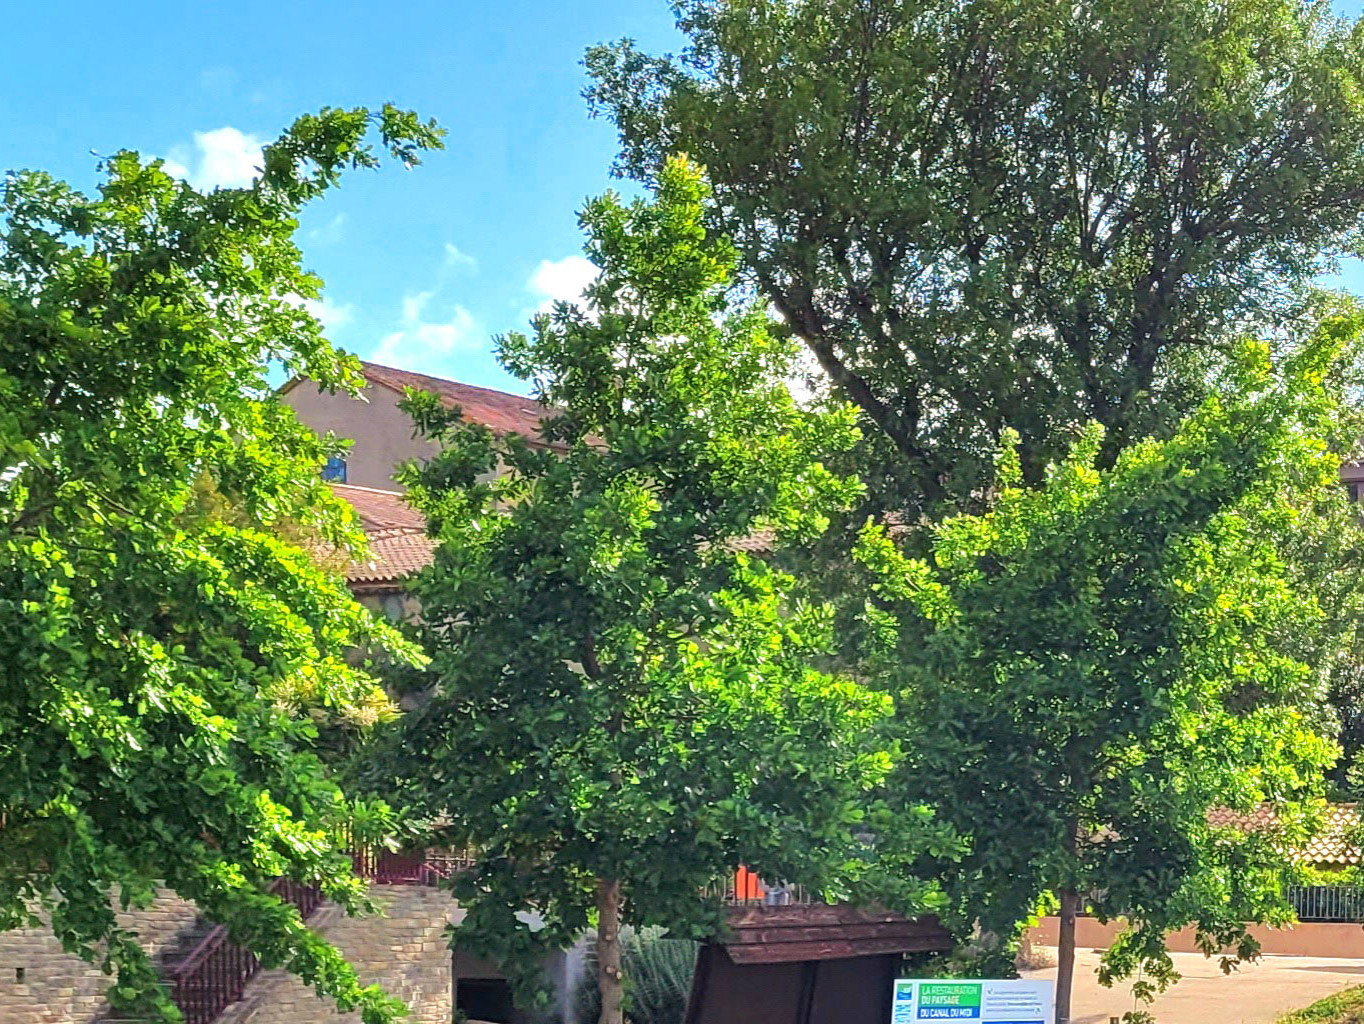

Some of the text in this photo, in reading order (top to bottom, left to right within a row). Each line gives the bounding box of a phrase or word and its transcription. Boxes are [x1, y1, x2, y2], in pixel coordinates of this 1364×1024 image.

[921, 995, 930, 1004] DU
[931, 995, 960, 1004] PAYSAGE
[920, 1008, 973, 1018] DU CANAL DU MIDI
